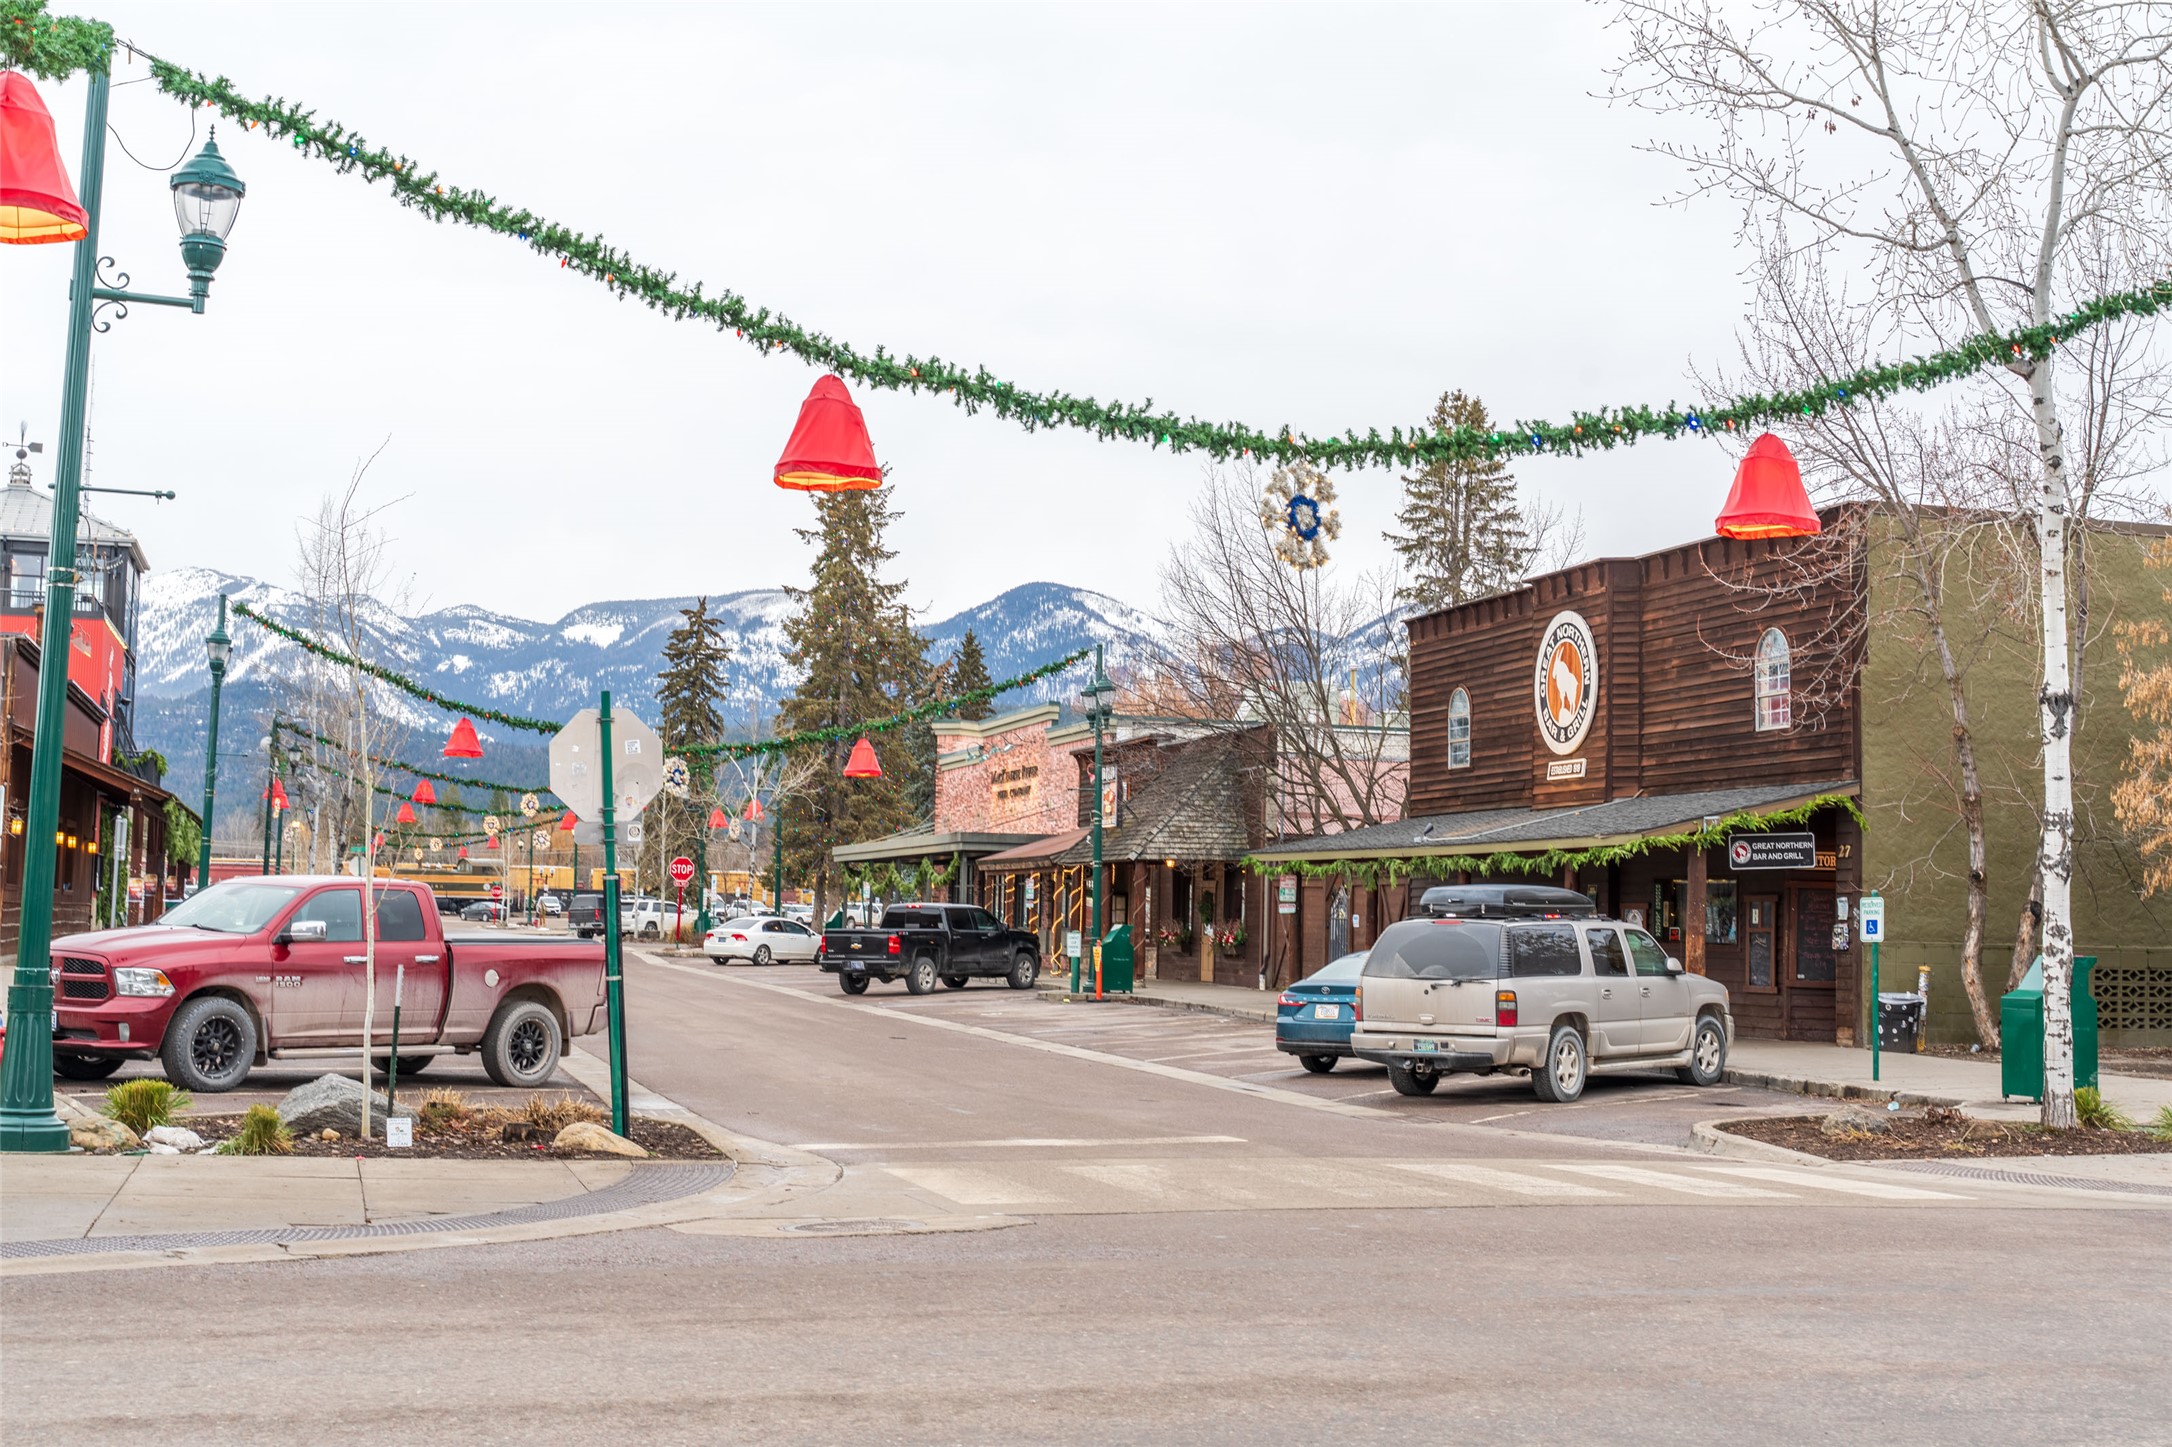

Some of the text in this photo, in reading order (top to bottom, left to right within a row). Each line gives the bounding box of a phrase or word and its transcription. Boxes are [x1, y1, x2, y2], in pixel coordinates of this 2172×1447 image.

[1540, 624, 1591, 698] GREAT NORTHERN
[1542, 698, 1589, 742] BAR & GRILL
[1752, 841, 1813, 850] GREAT NORTHERN
[1838, 844, 1851, 858] 27
[1752, 851, 1804, 860] BAR AND GRILL
[671, 864, 693, 875] STOP
